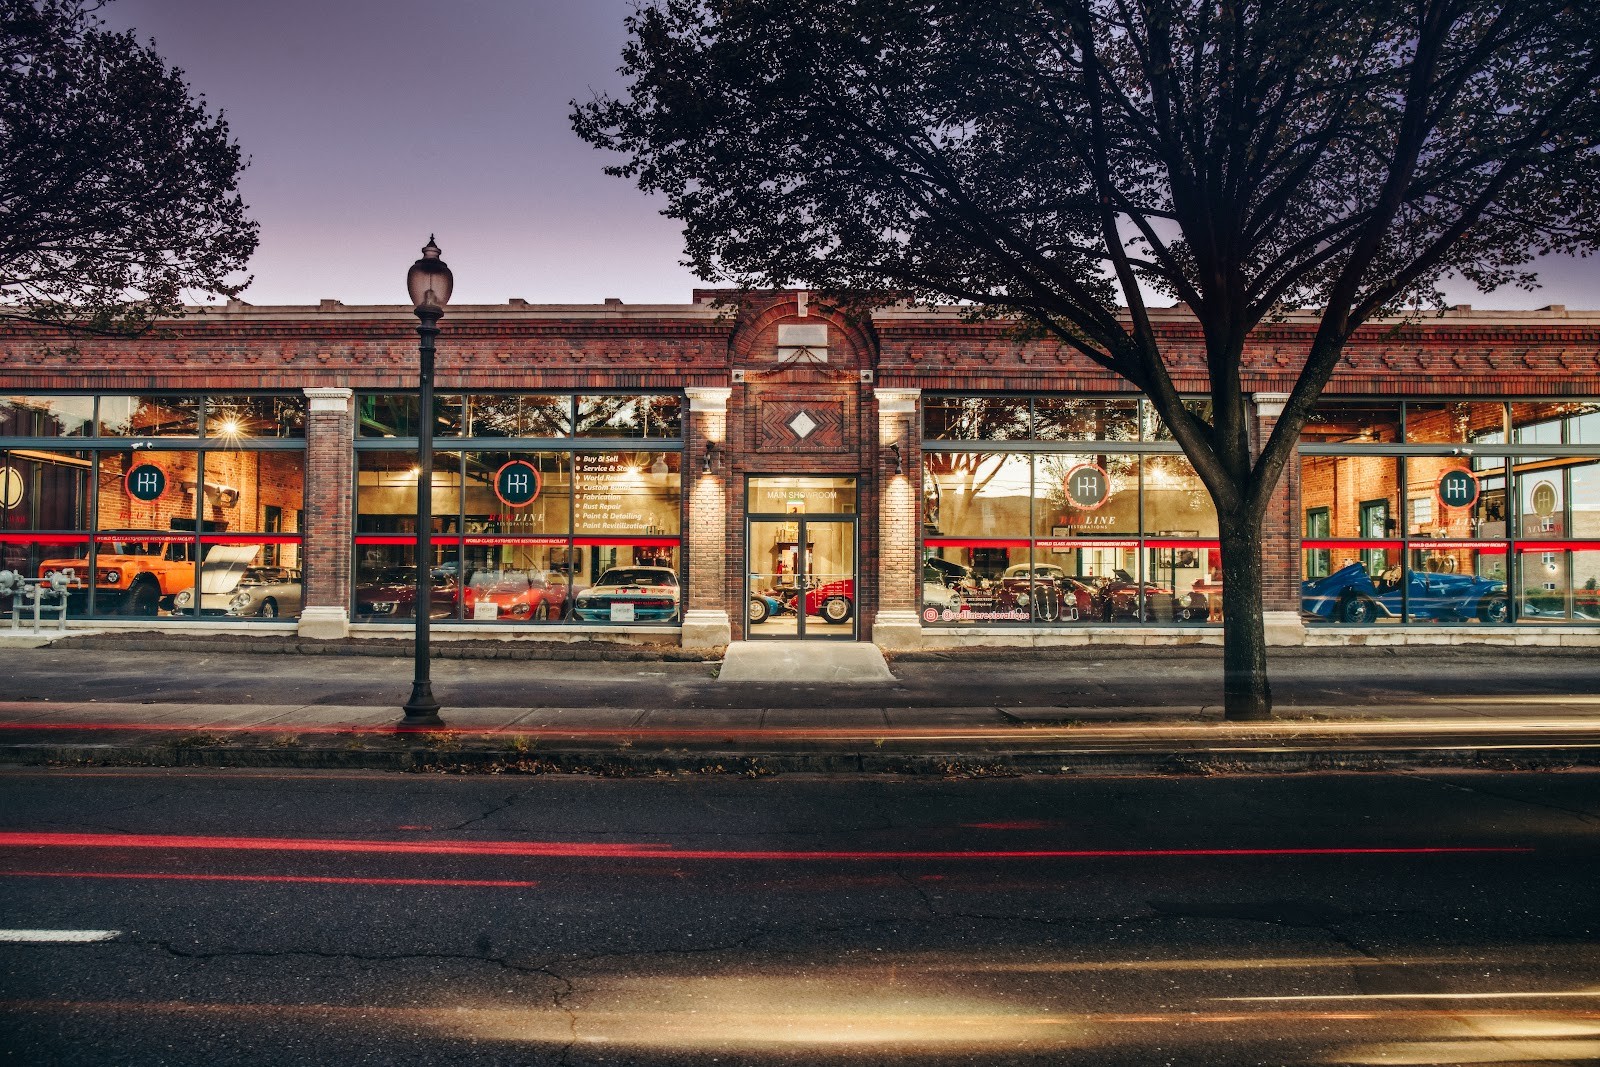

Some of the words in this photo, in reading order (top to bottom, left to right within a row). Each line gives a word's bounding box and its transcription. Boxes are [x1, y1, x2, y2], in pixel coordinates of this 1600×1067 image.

[767, 491, 787, 499] MAIN
[788, 491, 837, 499] SHOWROOM
[600, 504, 622, 512] Repair
[610, 513, 642, 521] Detailing
